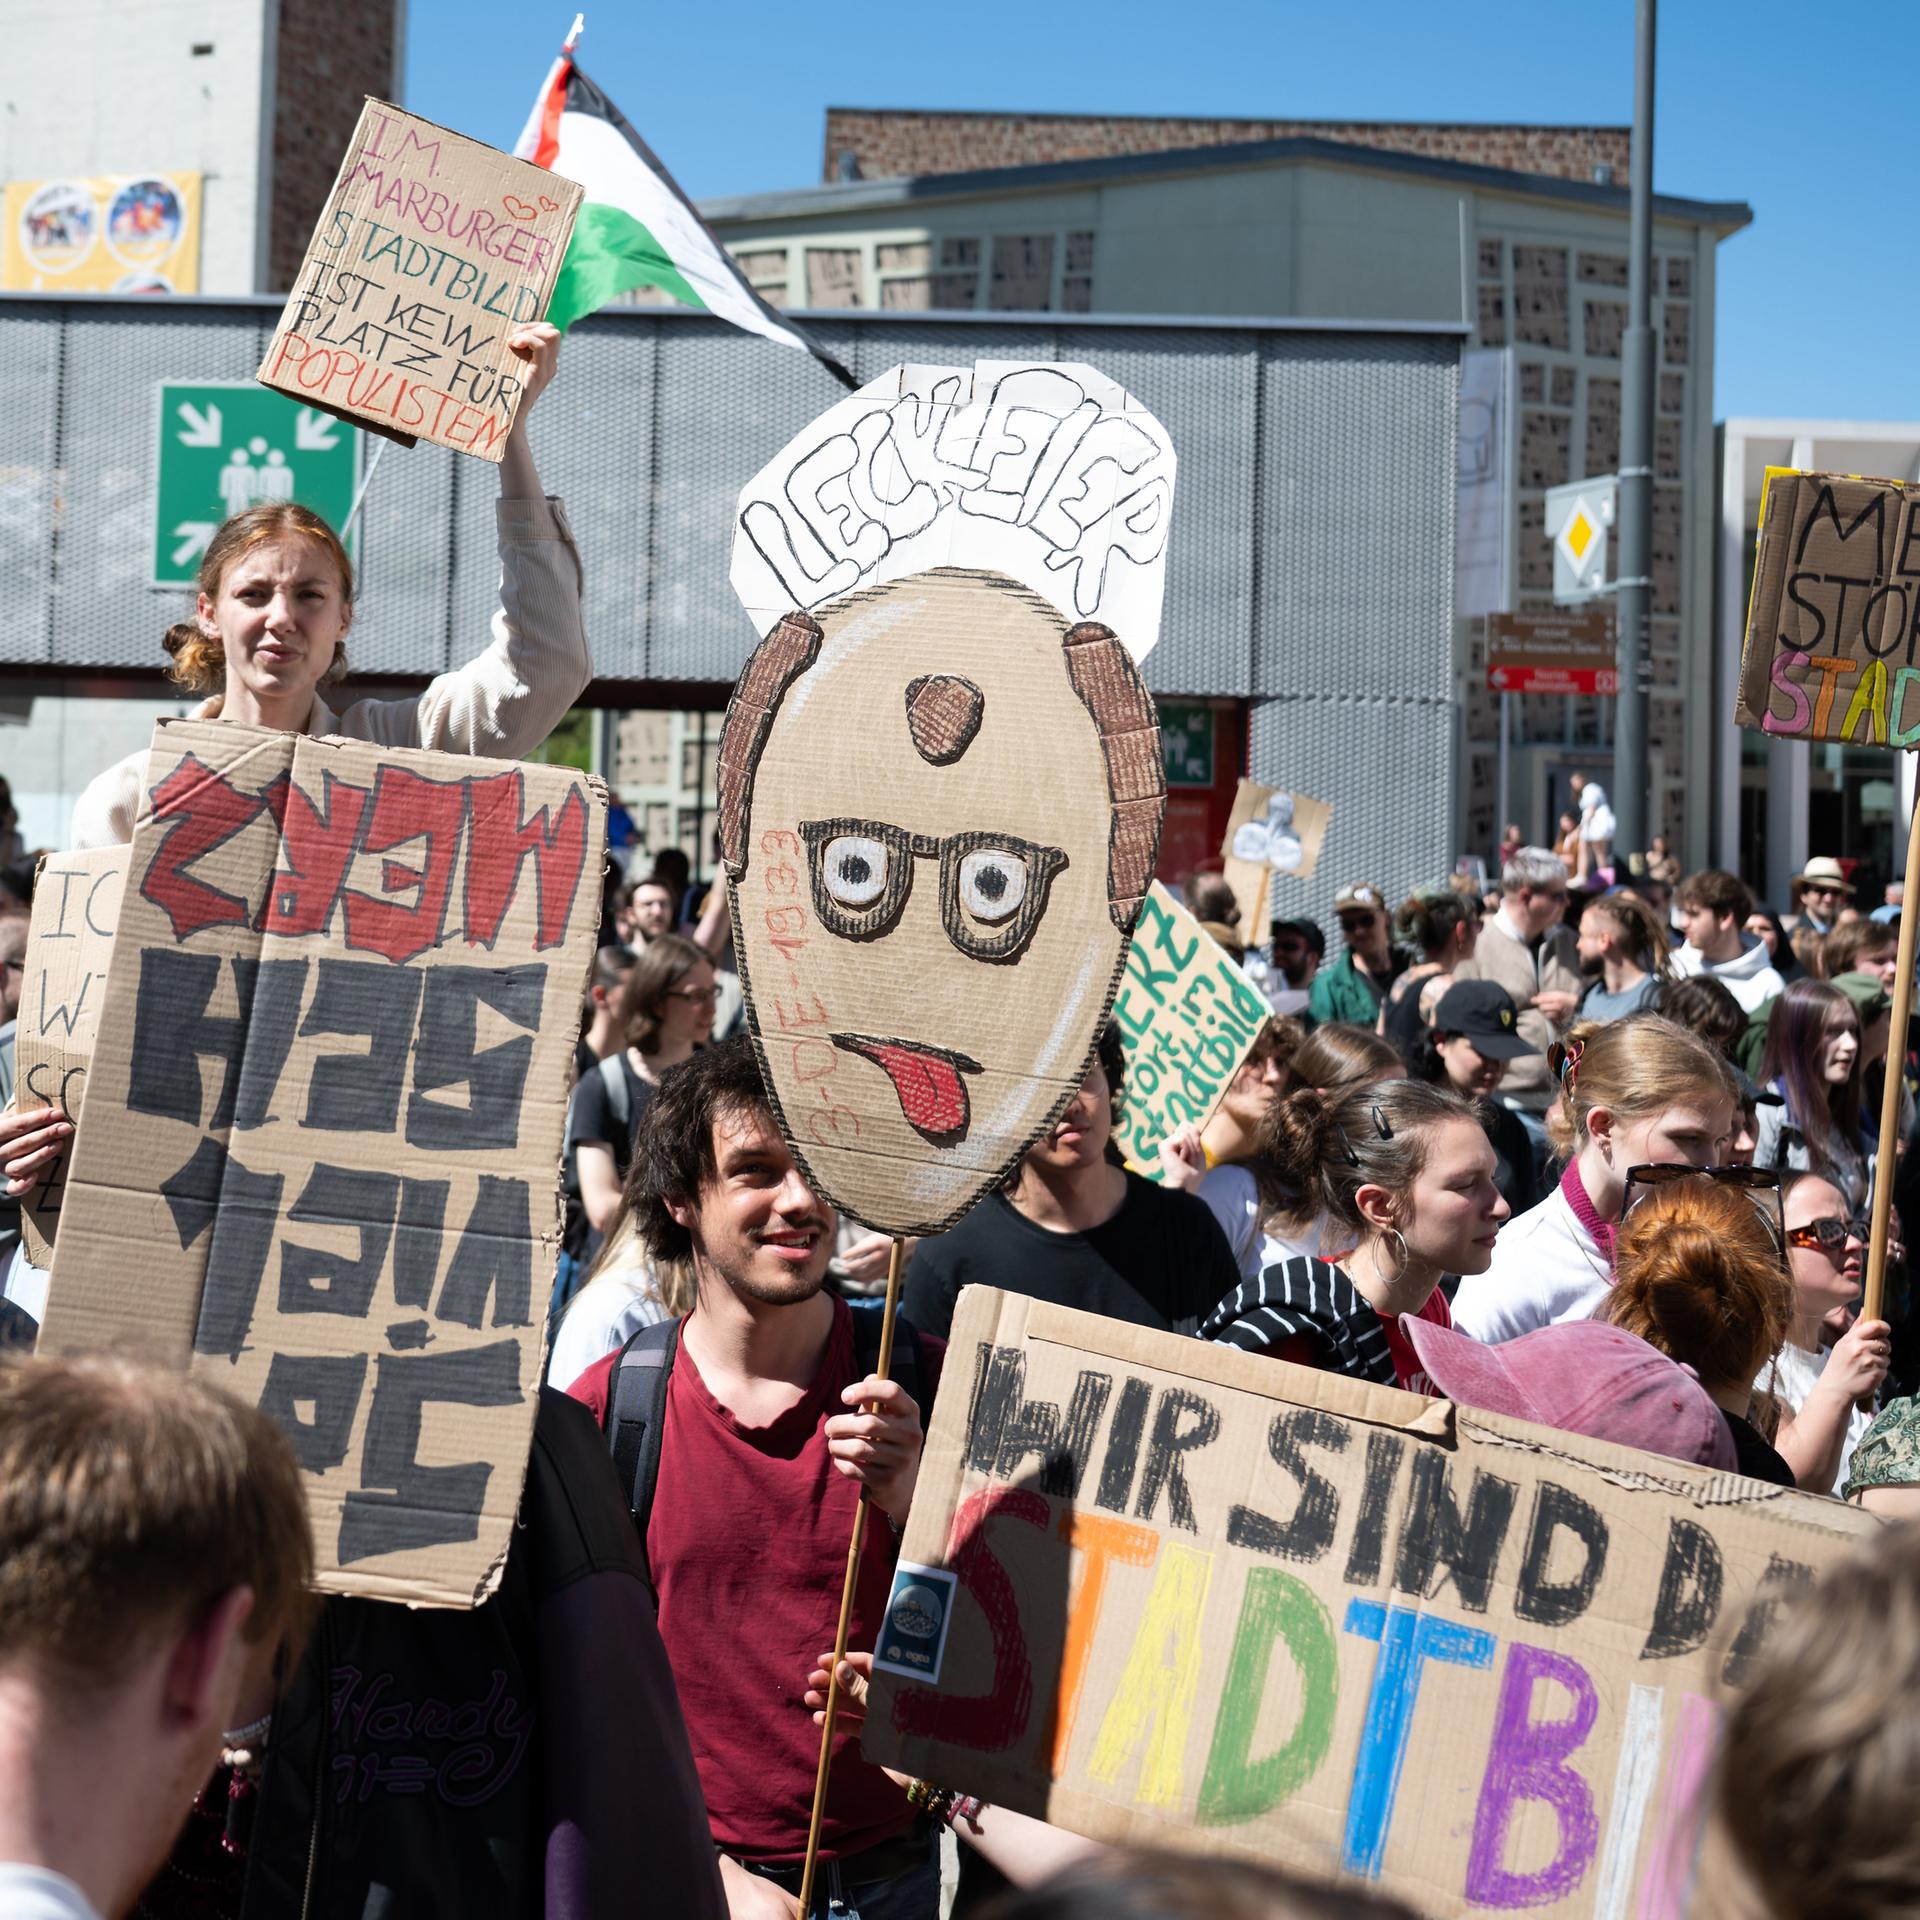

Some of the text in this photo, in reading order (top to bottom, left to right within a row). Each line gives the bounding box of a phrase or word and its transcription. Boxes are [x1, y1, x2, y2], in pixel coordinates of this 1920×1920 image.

[360, 110, 440, 178] IM
[322, 211, 540, 324] STADTBILD
[339, 161, 554, 276] MARBURGER
[290, 300, 522, 415] PLATZ FÜR
[301, 260, 496, 357] IST KEIN
[271, 331, 511, 449] POPULISTEN
[140, 751, 591, 964] MERZ
[1113, 895, 1200, 1049] ERZ
[1169, 974, 1217, 1027] im
[961, 1341, 1222, 1536] WIR
[1226, 1409, 1610, 1627] SIND
